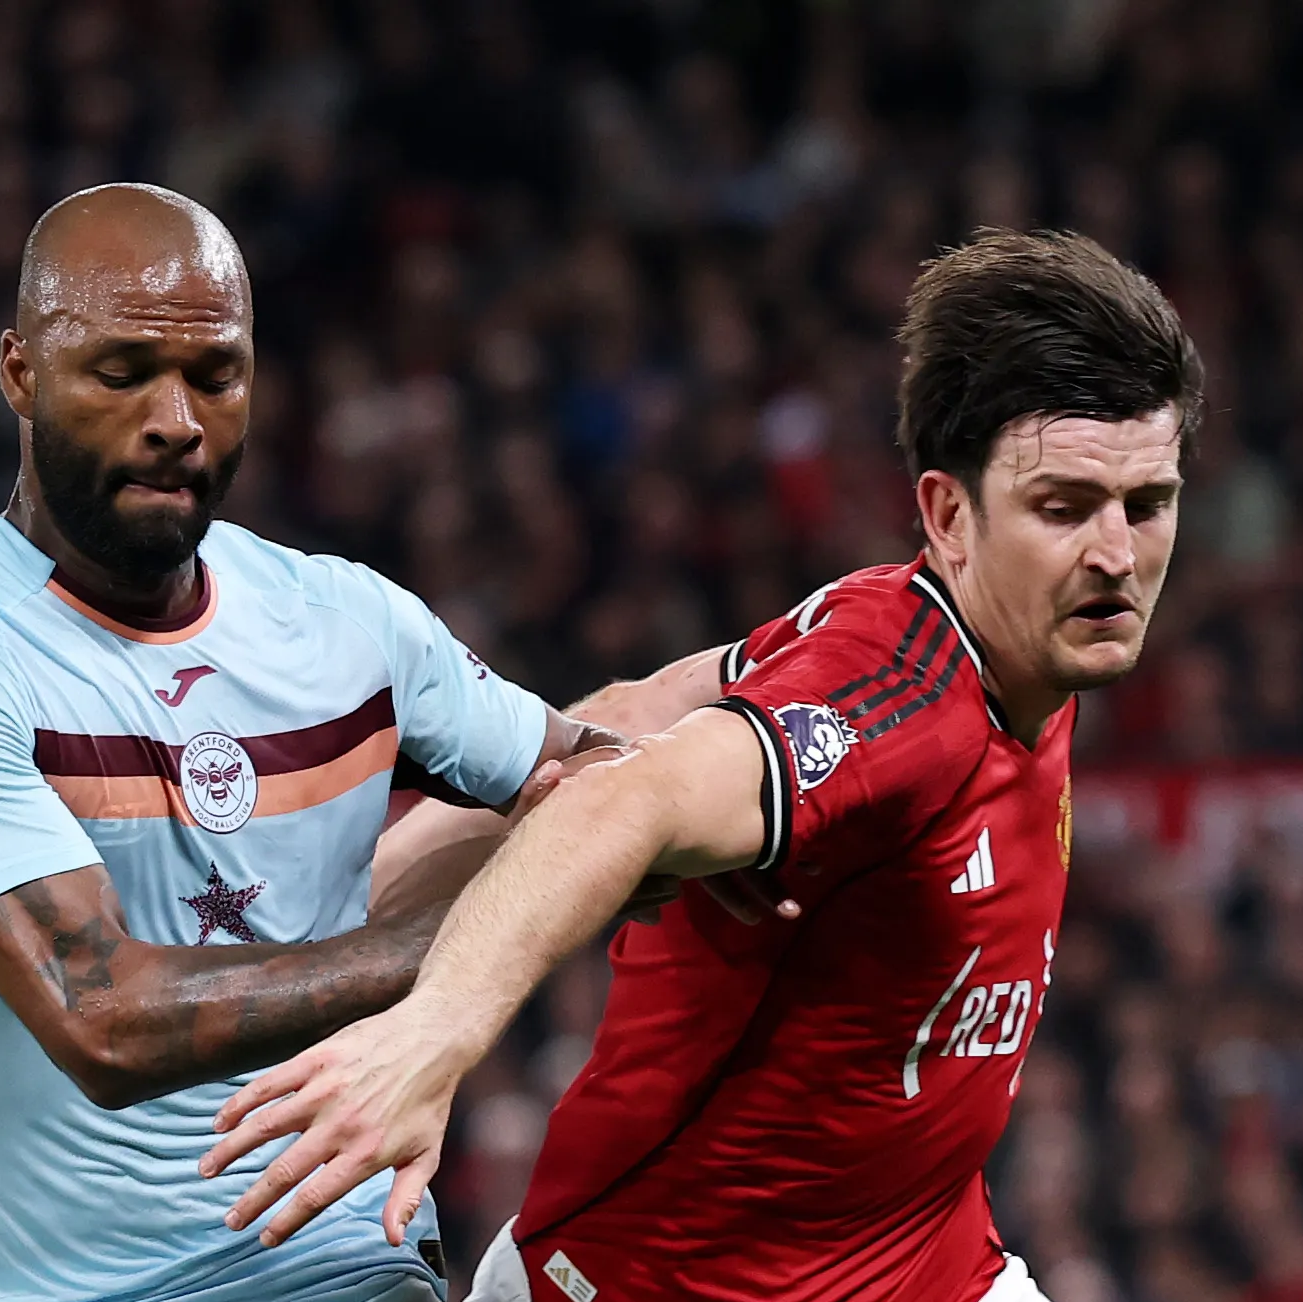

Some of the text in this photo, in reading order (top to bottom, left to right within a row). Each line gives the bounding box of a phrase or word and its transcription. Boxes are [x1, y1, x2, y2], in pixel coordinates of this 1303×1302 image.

[184, 736, 241, 764] BRENTFORD
[194, 801, 251, 829] FOOTBALL CLUB
